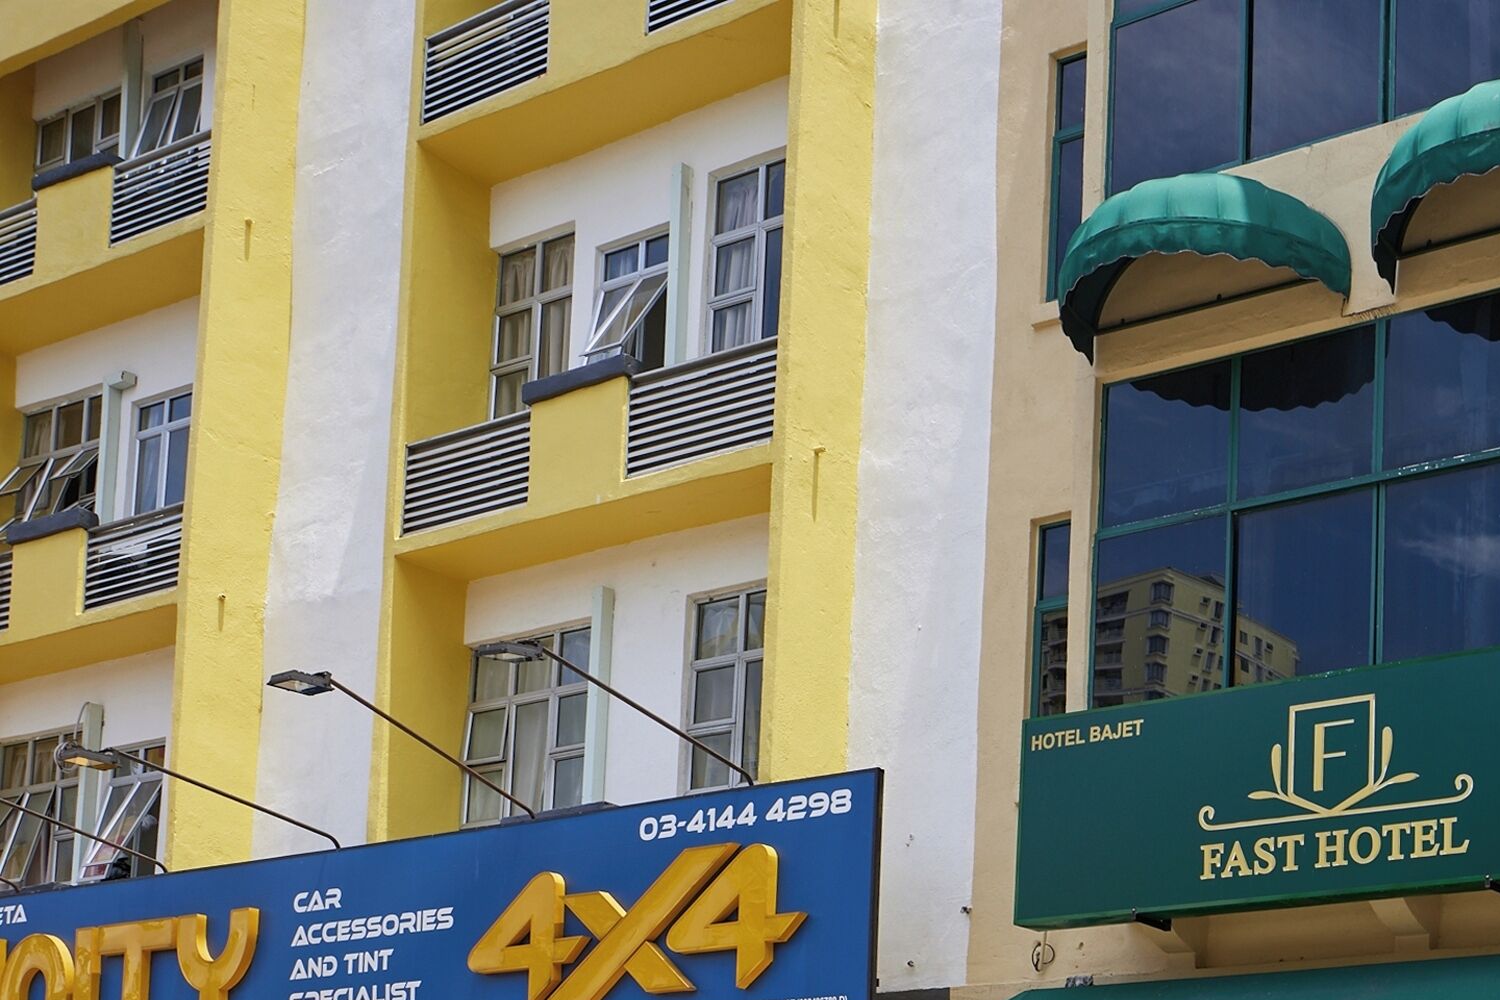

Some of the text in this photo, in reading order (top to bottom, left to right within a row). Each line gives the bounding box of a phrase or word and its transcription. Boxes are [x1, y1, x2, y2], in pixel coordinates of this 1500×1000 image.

[1030, 719, 1144, 751] HOTEL BAJET
[1313, 718, 1355, 792] F
[639, 789, 852, 841] 03-4144 4298
[1200, 816, 1470, 880] FAST HOTEL
[293, 887, 342, 913] CAR
[290, 906, 454, 947] ACCESSORIES
[289, 948, 394, 981] AND TINT
